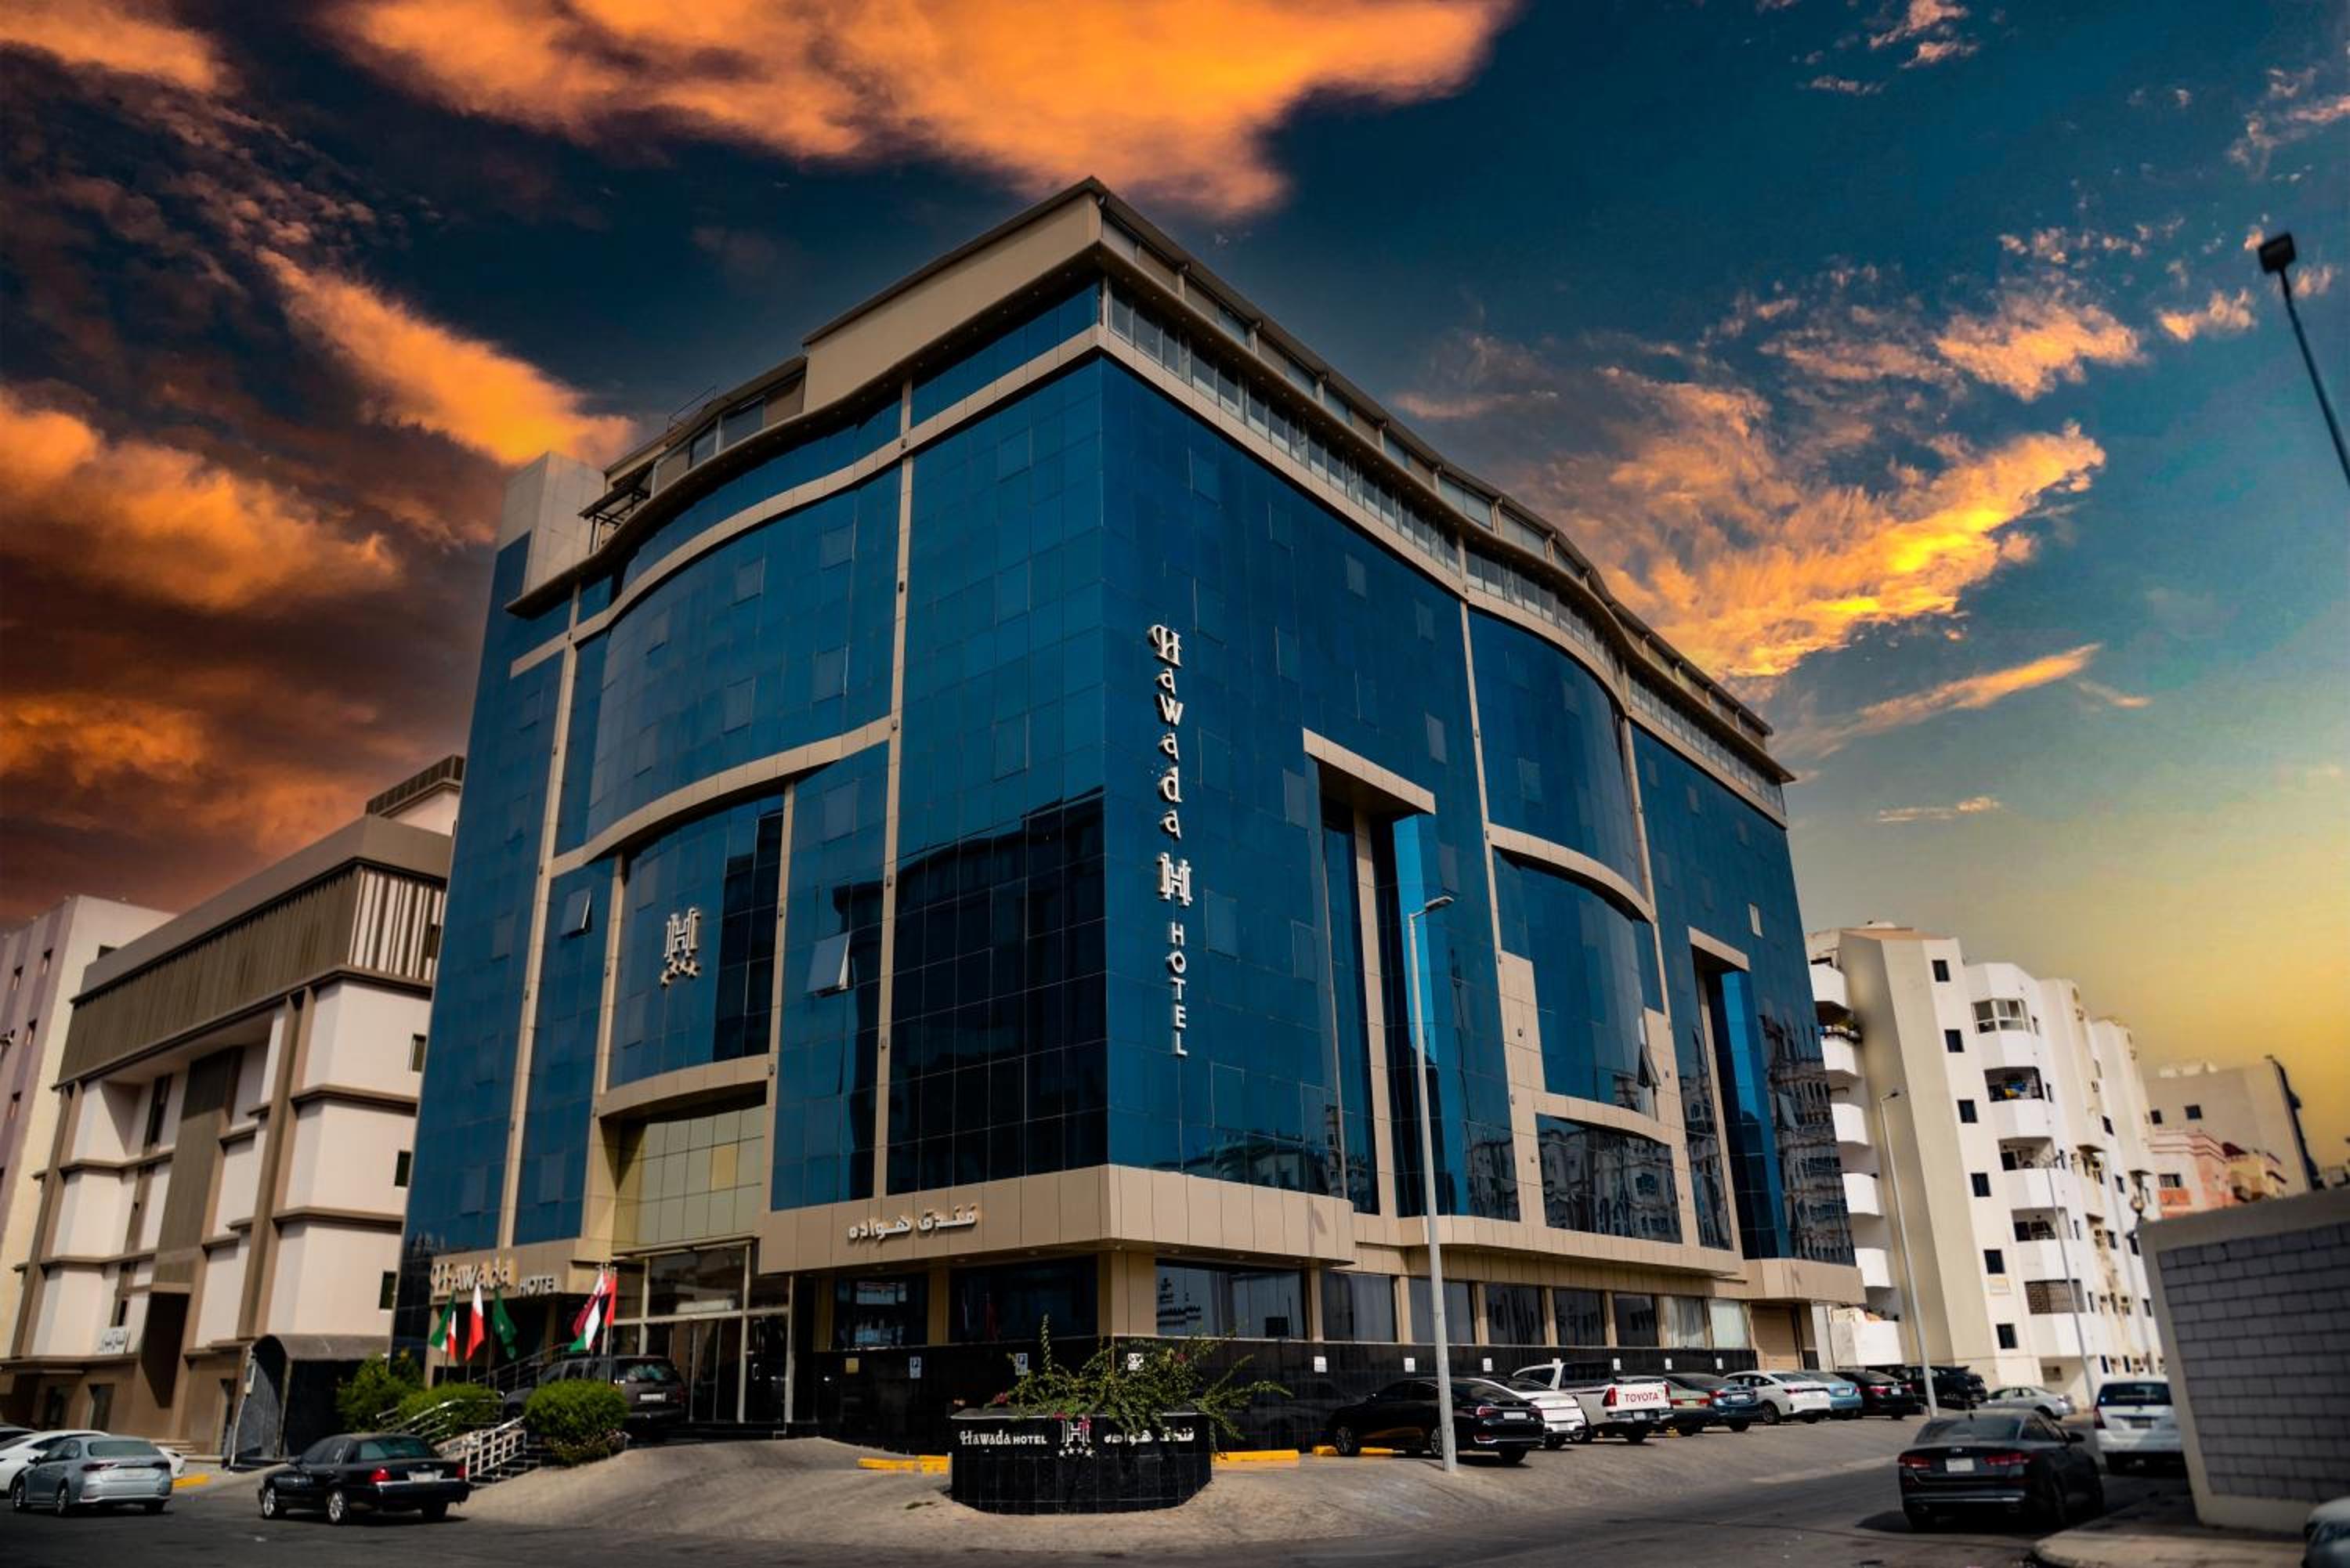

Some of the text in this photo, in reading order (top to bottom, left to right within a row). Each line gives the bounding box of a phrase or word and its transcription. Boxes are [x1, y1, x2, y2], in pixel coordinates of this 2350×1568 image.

[1166, 922, 1188, 1057] HOTEL
[917, 1203, 978, 1230] فندق
[519, 1274, 564, 1294] HOTEL
[1625, 1392, 1659, 1403] TOYOTA
[960, 1429, 1047, 1445] Hawada HOTEL
